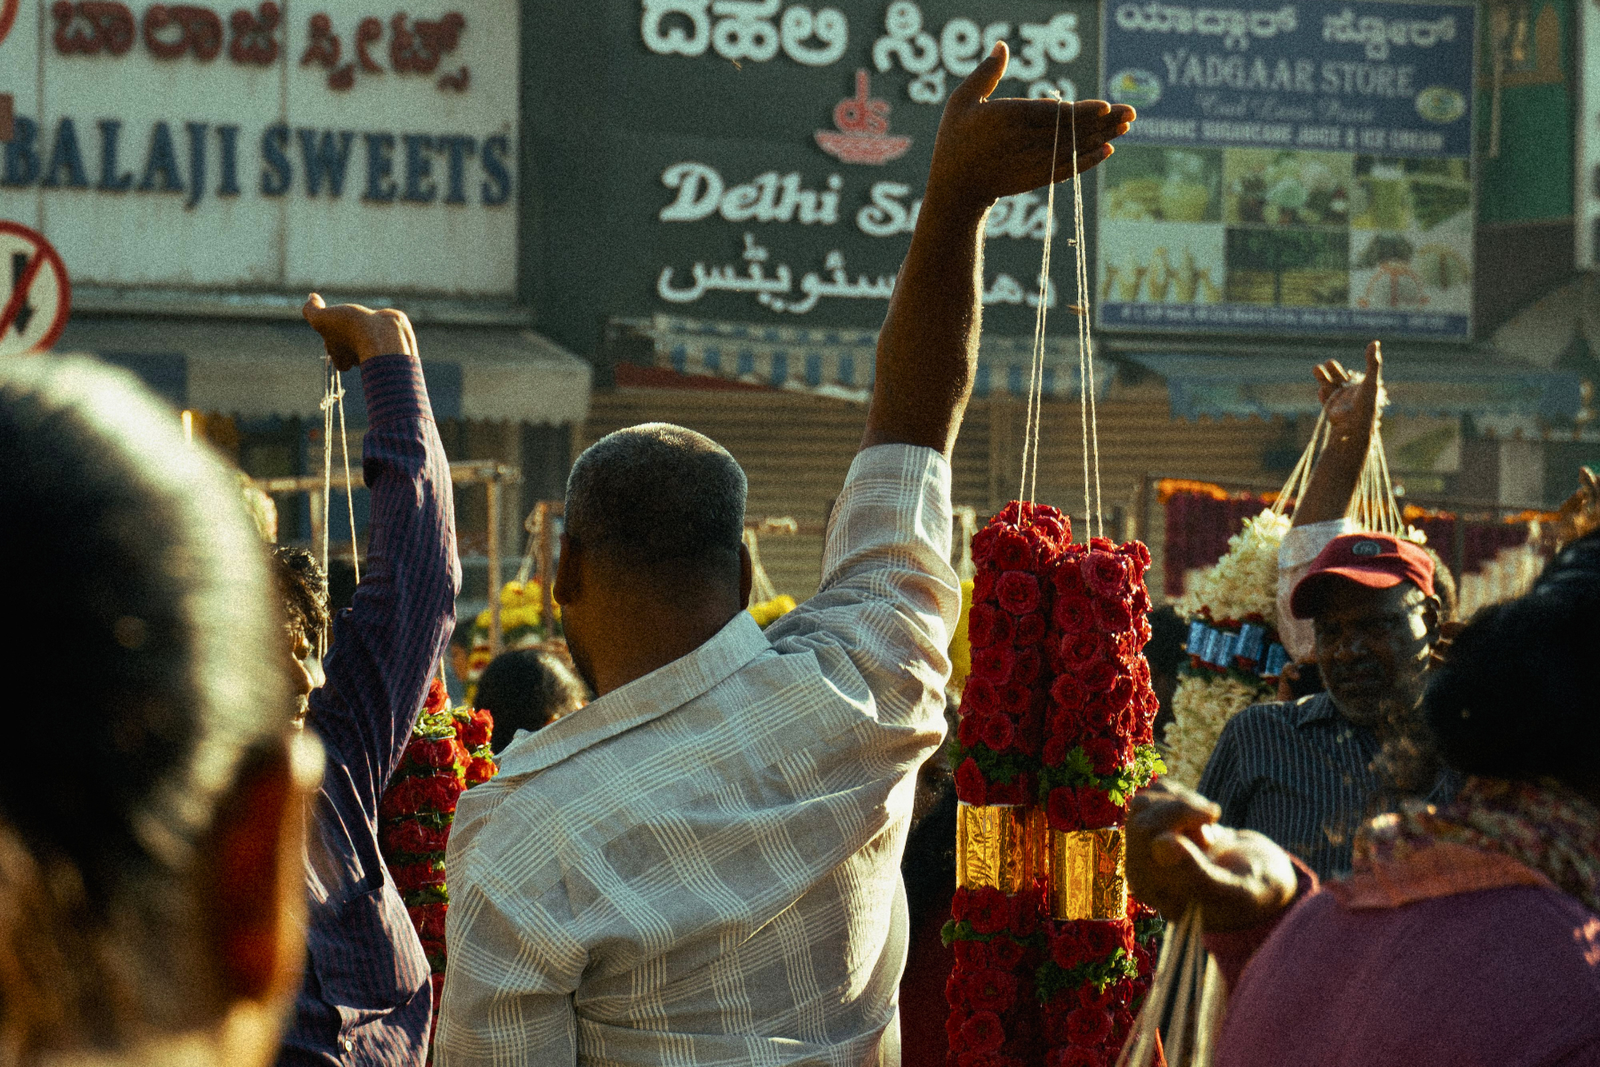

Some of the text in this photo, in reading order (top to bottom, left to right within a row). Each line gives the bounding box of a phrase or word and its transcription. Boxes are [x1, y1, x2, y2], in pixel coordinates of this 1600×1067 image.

[1162, 51, 1416, 98] YADGAAR STORE
[1, 114, 513, 211] BALAJI SWEETS
[660, 161, 1058, 240] Delhi Sets
